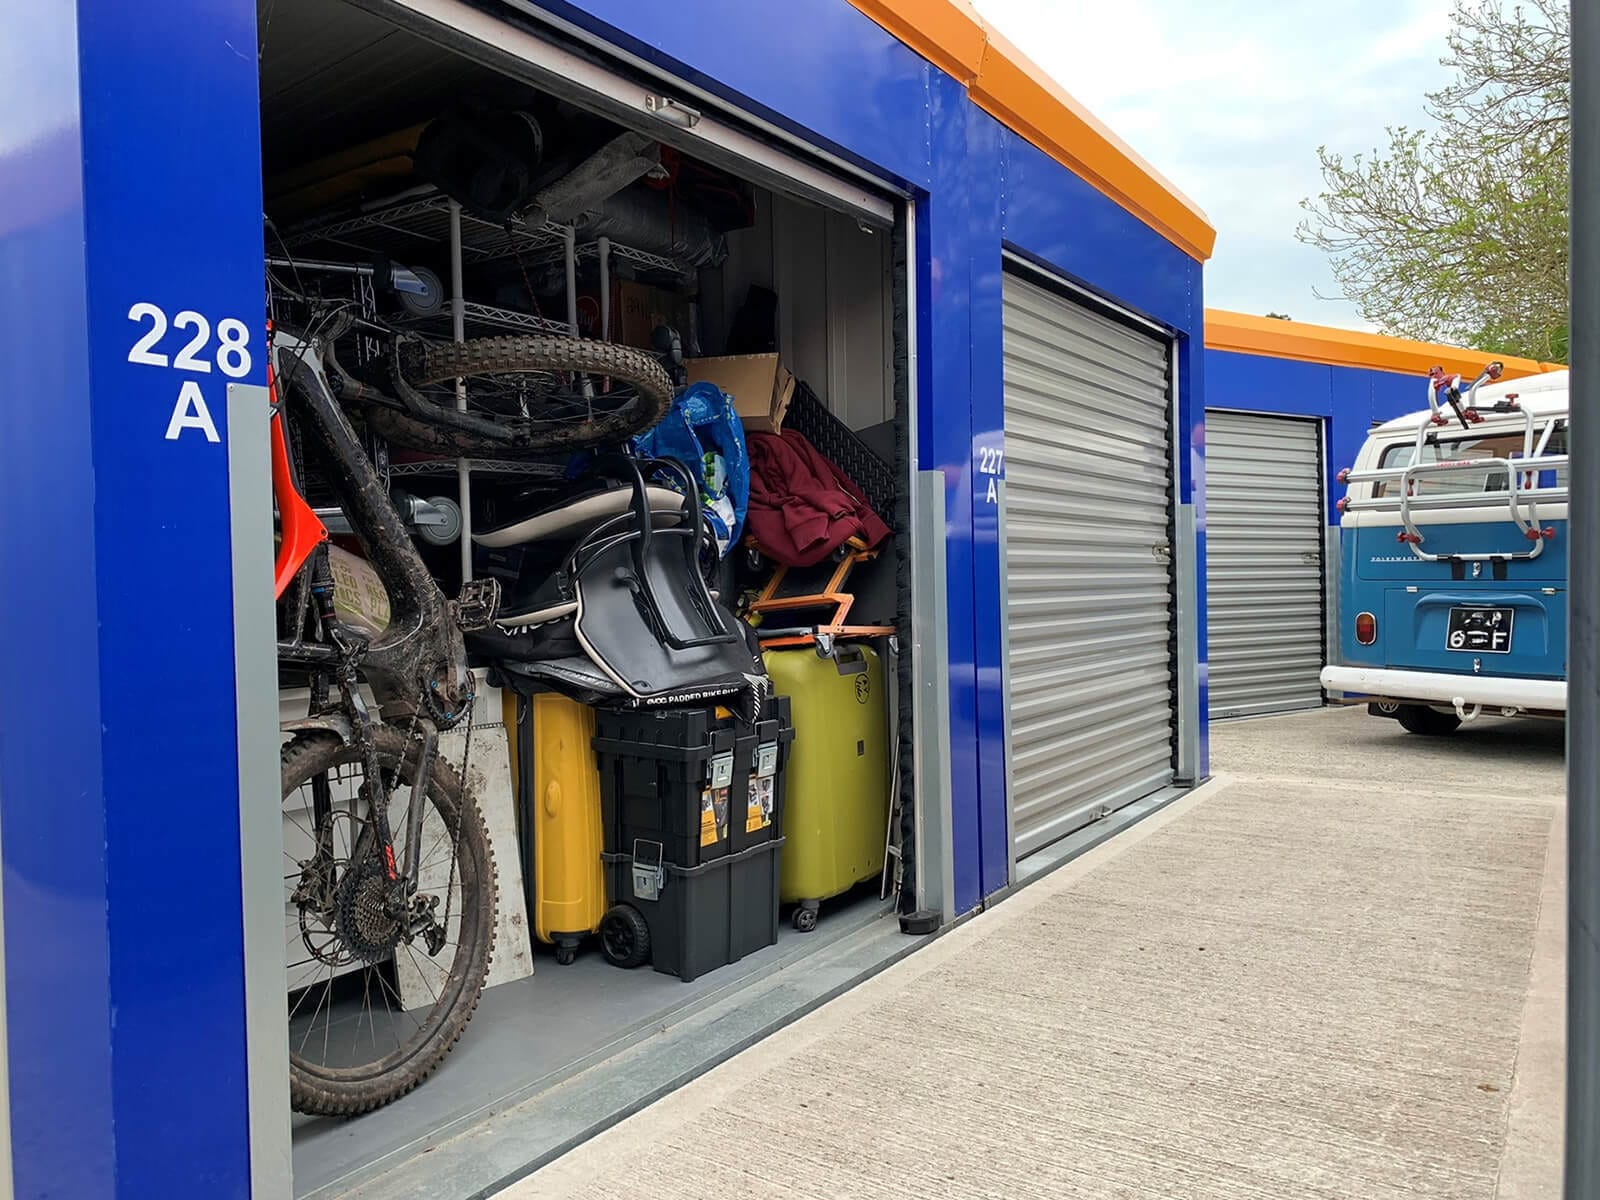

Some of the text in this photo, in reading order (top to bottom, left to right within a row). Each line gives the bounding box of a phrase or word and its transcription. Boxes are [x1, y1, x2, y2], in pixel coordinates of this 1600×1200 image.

[128, 302, 252, 378] 228
[165, 381, 221, 443] A
[980, 446, 1003, 475] 227
[986, 477, 998, 505] A
[668, 692, 702, 703] PADDED
